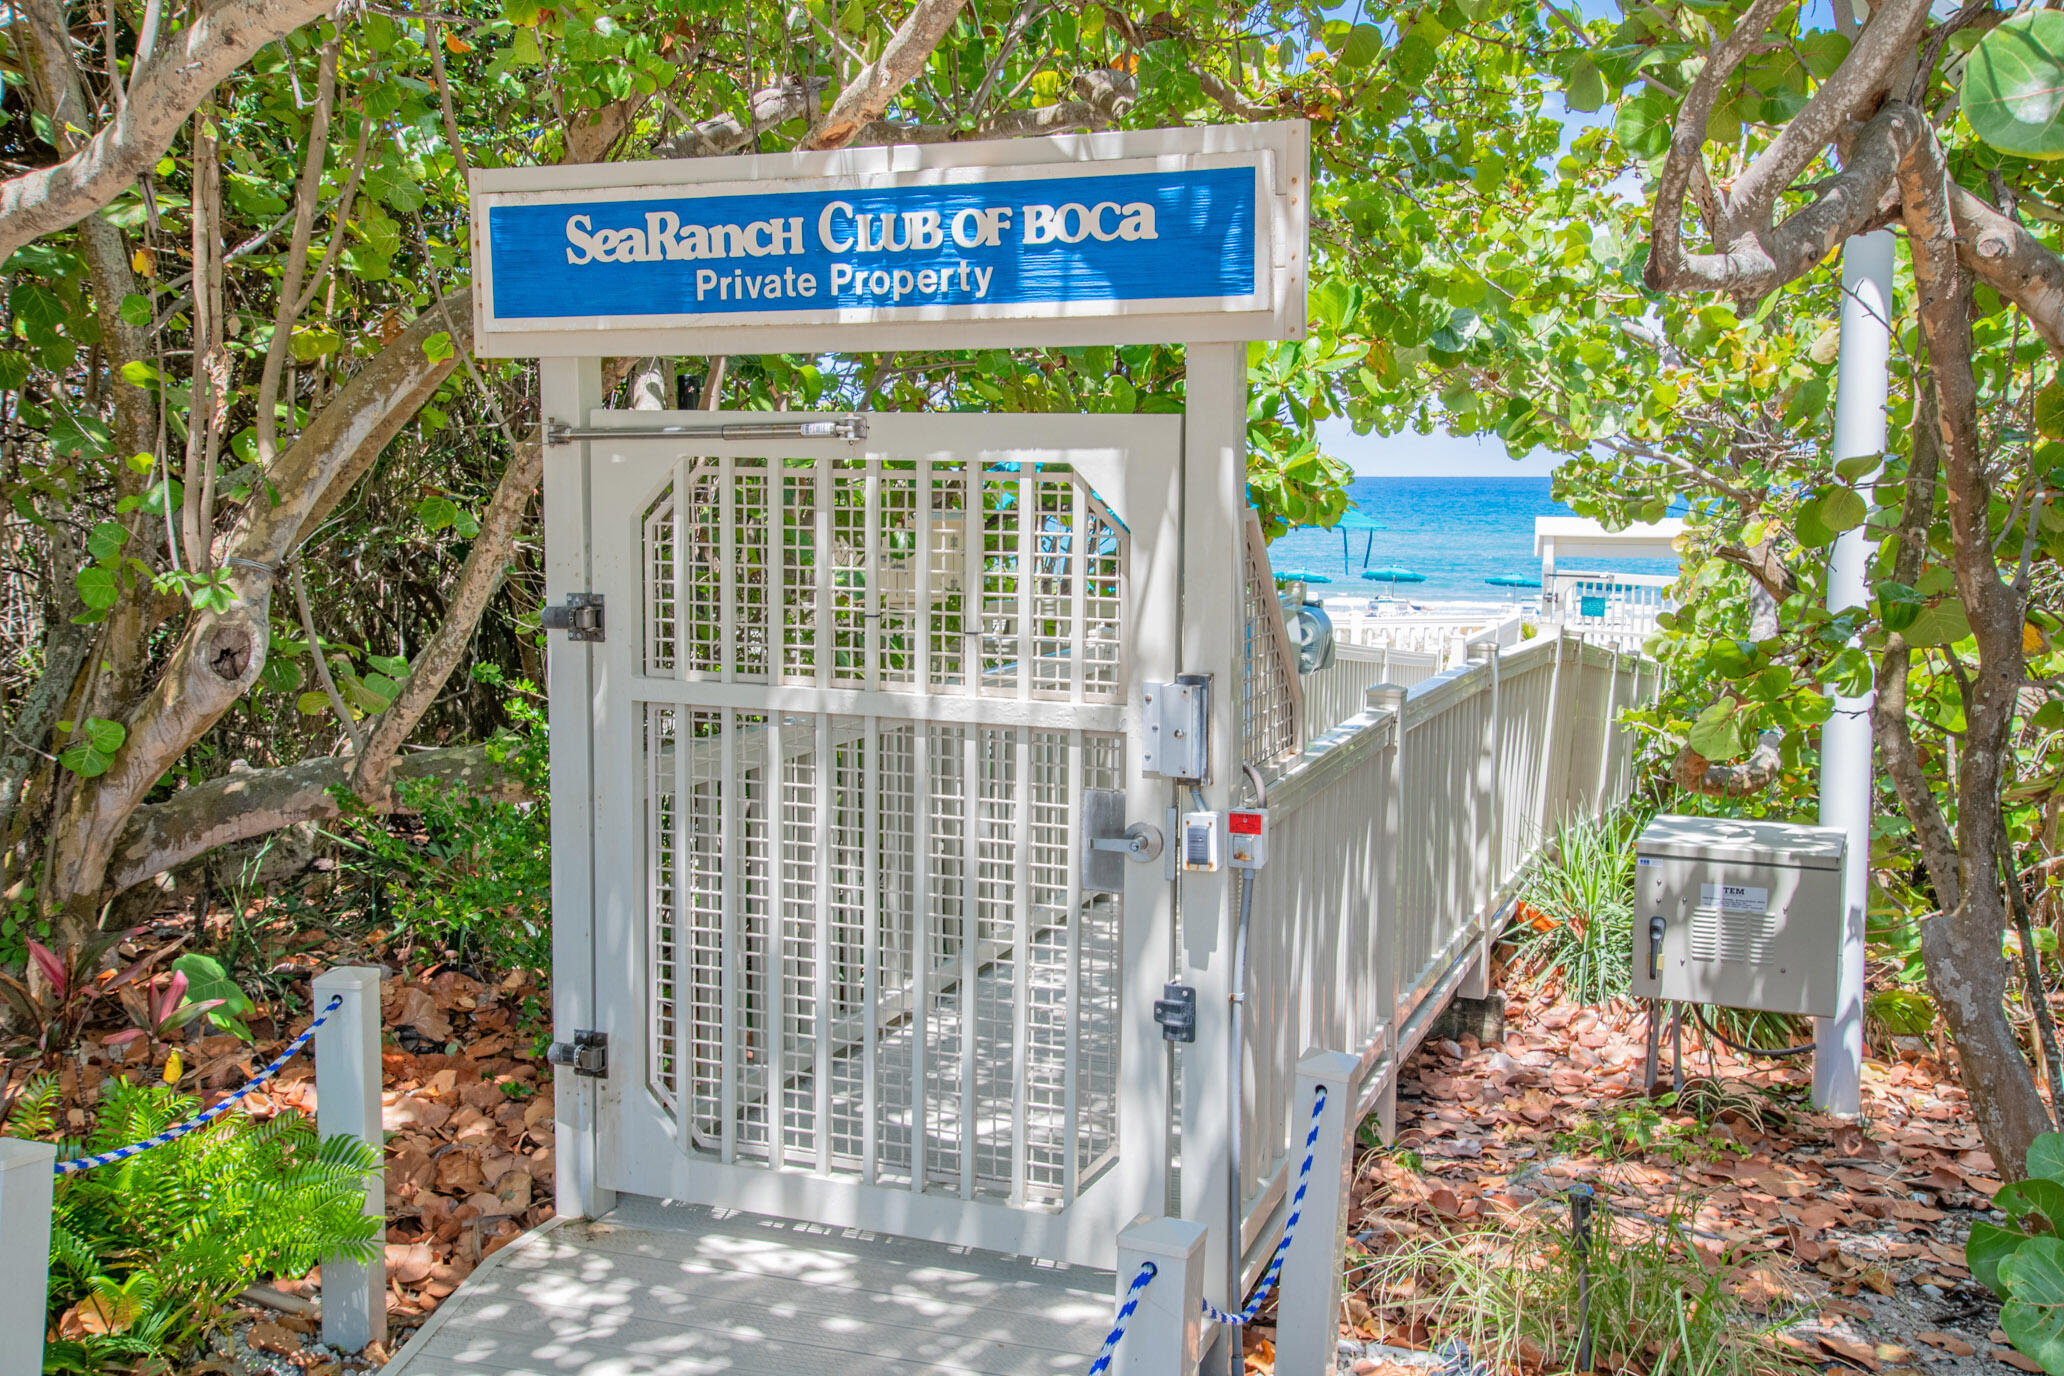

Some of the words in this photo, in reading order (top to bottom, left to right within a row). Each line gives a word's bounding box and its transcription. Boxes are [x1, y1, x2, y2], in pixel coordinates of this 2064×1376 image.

[818, 200, 944, 254] CLUB
[951, 207, 1013, 248] OF
[696, 266, 817, 301] Private
[830, 260, 994, 302] Property
[1723, 887, 1745, 895] TEM
